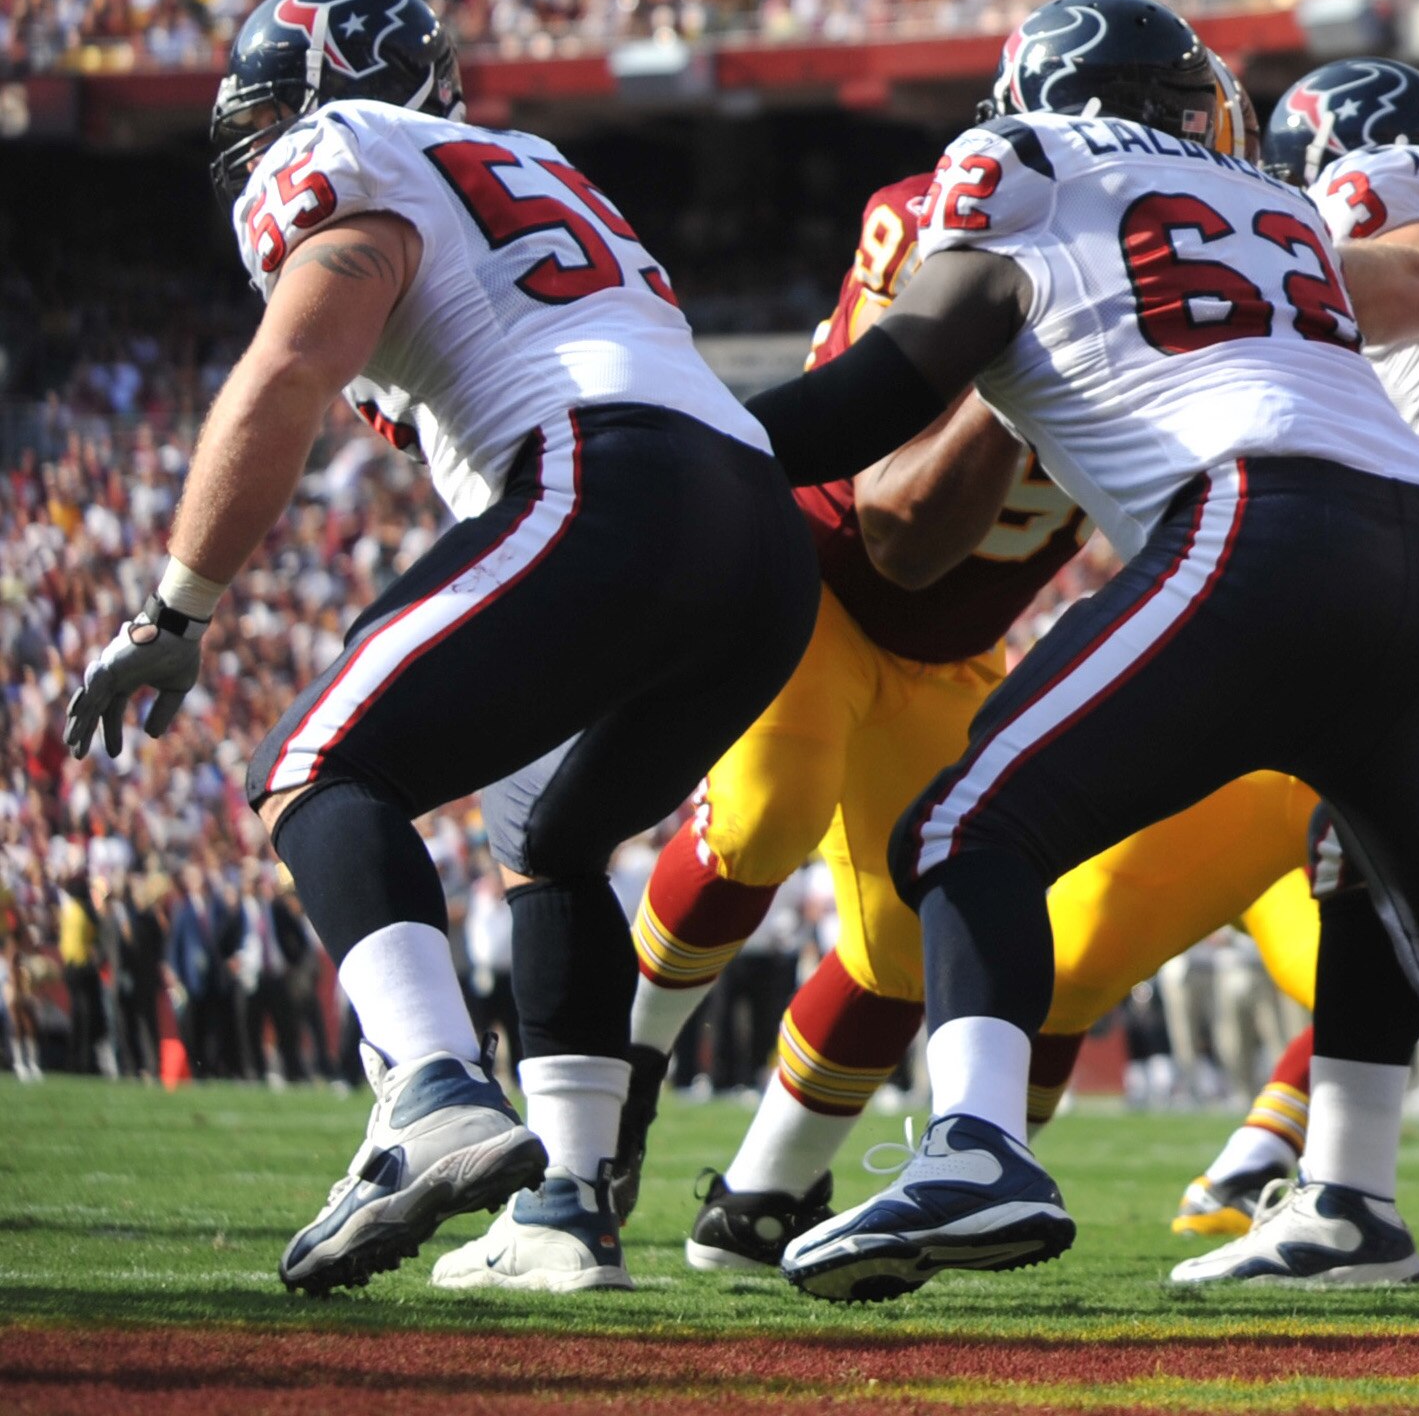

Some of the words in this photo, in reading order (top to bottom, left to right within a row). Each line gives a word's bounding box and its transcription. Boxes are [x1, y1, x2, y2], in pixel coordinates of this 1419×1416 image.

[246, 151, 337, 274] 55
[424, 140, 684, 310] 55
[1067, 119, 1320, 212] CALDWE
[1324, 170, 1389, 240] 3
[1118, 190, 1364, 356] 62
